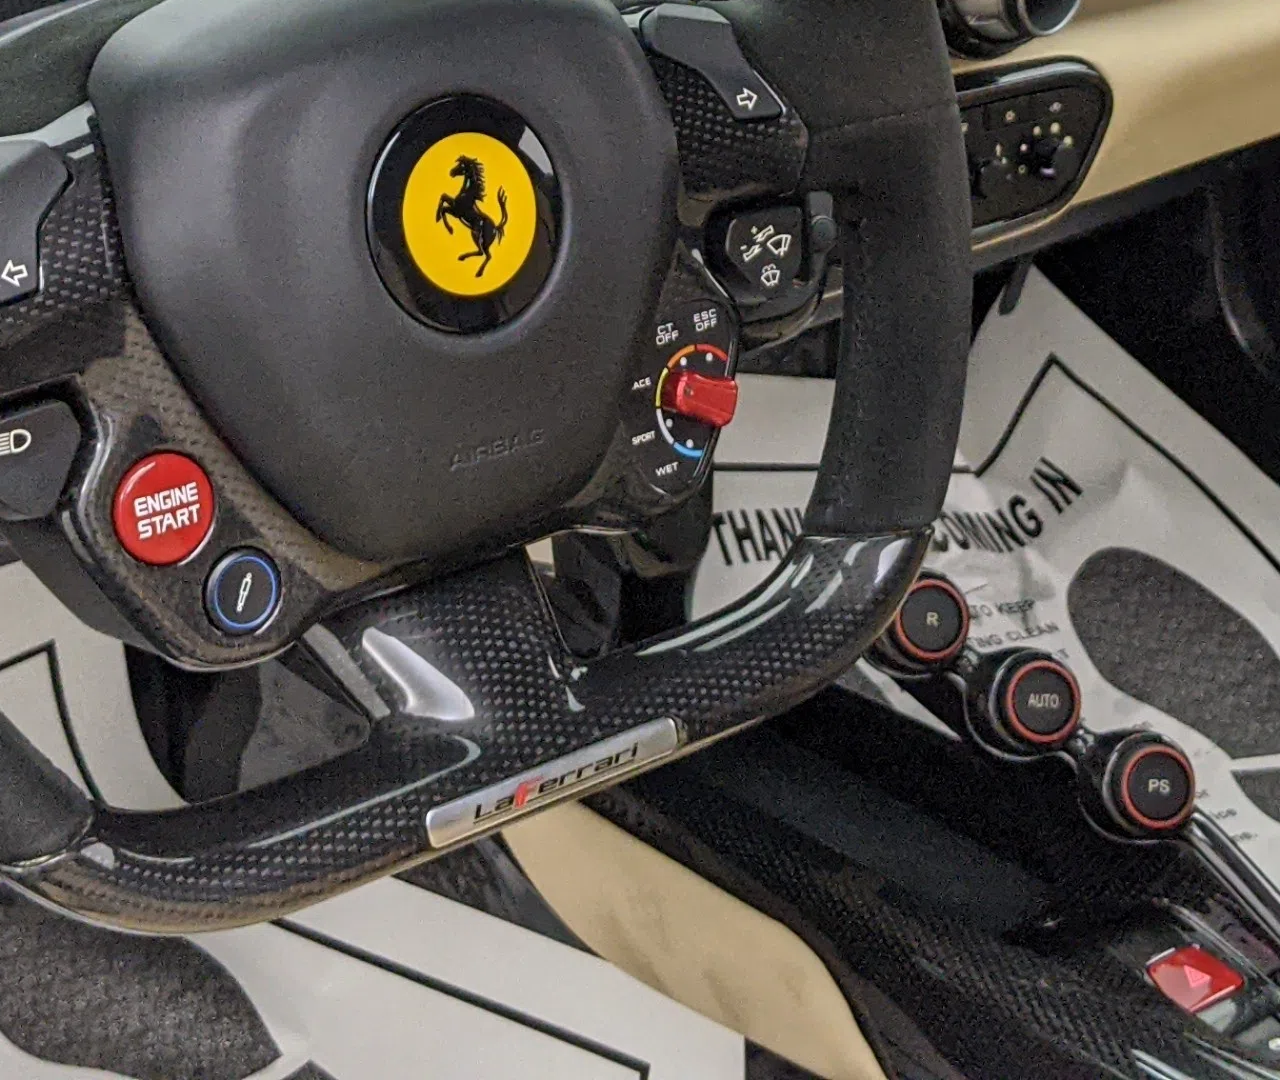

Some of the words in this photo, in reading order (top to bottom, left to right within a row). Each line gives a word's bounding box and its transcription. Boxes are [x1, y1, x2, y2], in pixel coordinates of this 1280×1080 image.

[693, 309, 717, 322] ESC
[657, 322, 674, 335] CT
[696, 318, 718, 332] OFF
[656, 330, 679, 345] OFF
[632, 377, 652, 390] ACE
[632, 430, 656, 445] SPORT
[655, 462, 679, 476] WET
[134, 482, 199, 517] ENGINE
[713, 508, 803, 566] THAN
[1029, 456, 1084, 514] IN
[137, 504, 200, 539] START
[926, 612, 939, 627] R
[1027, 693, 1059, 709] AUTO
[474, 742, 638, 820] LaFerrari
[1148, 779, 1170, 794] PS
